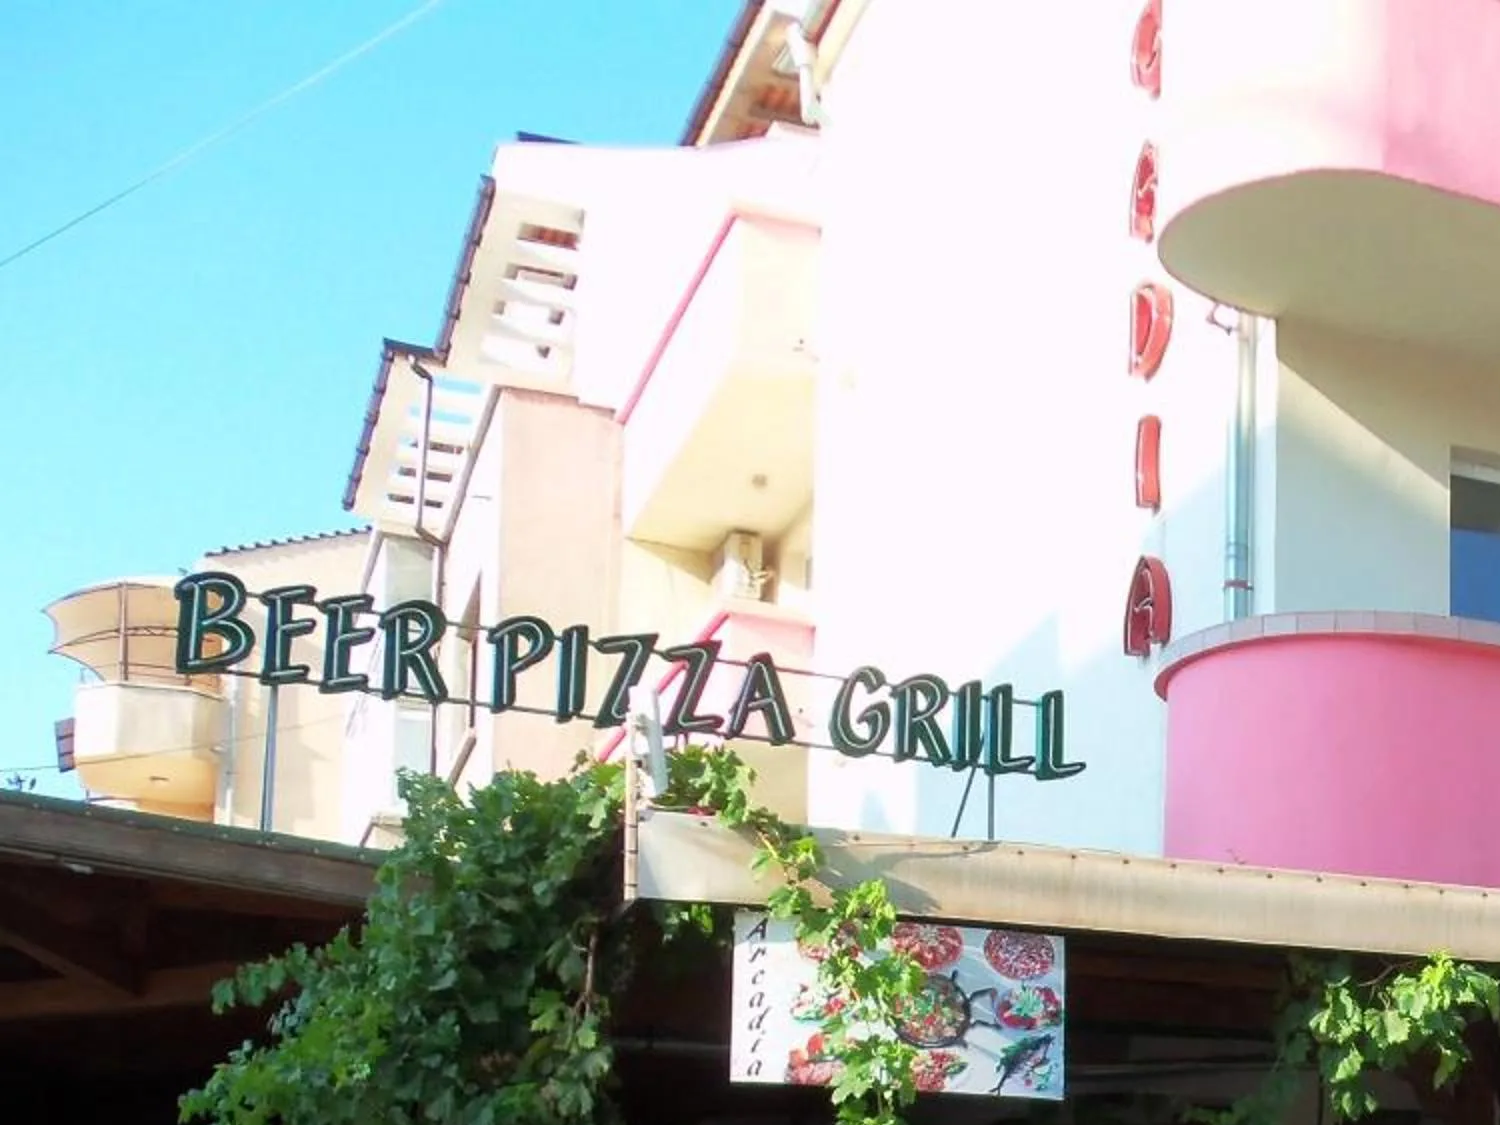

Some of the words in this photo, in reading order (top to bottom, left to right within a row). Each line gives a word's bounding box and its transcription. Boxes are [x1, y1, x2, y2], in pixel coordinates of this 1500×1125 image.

[174, 571, 449, 702] BEER
[487, 614, 797, 745] PIZZA
[828, 664, 1087, 781] GRILL
[746, 916, 770, 1077] Arcadia
